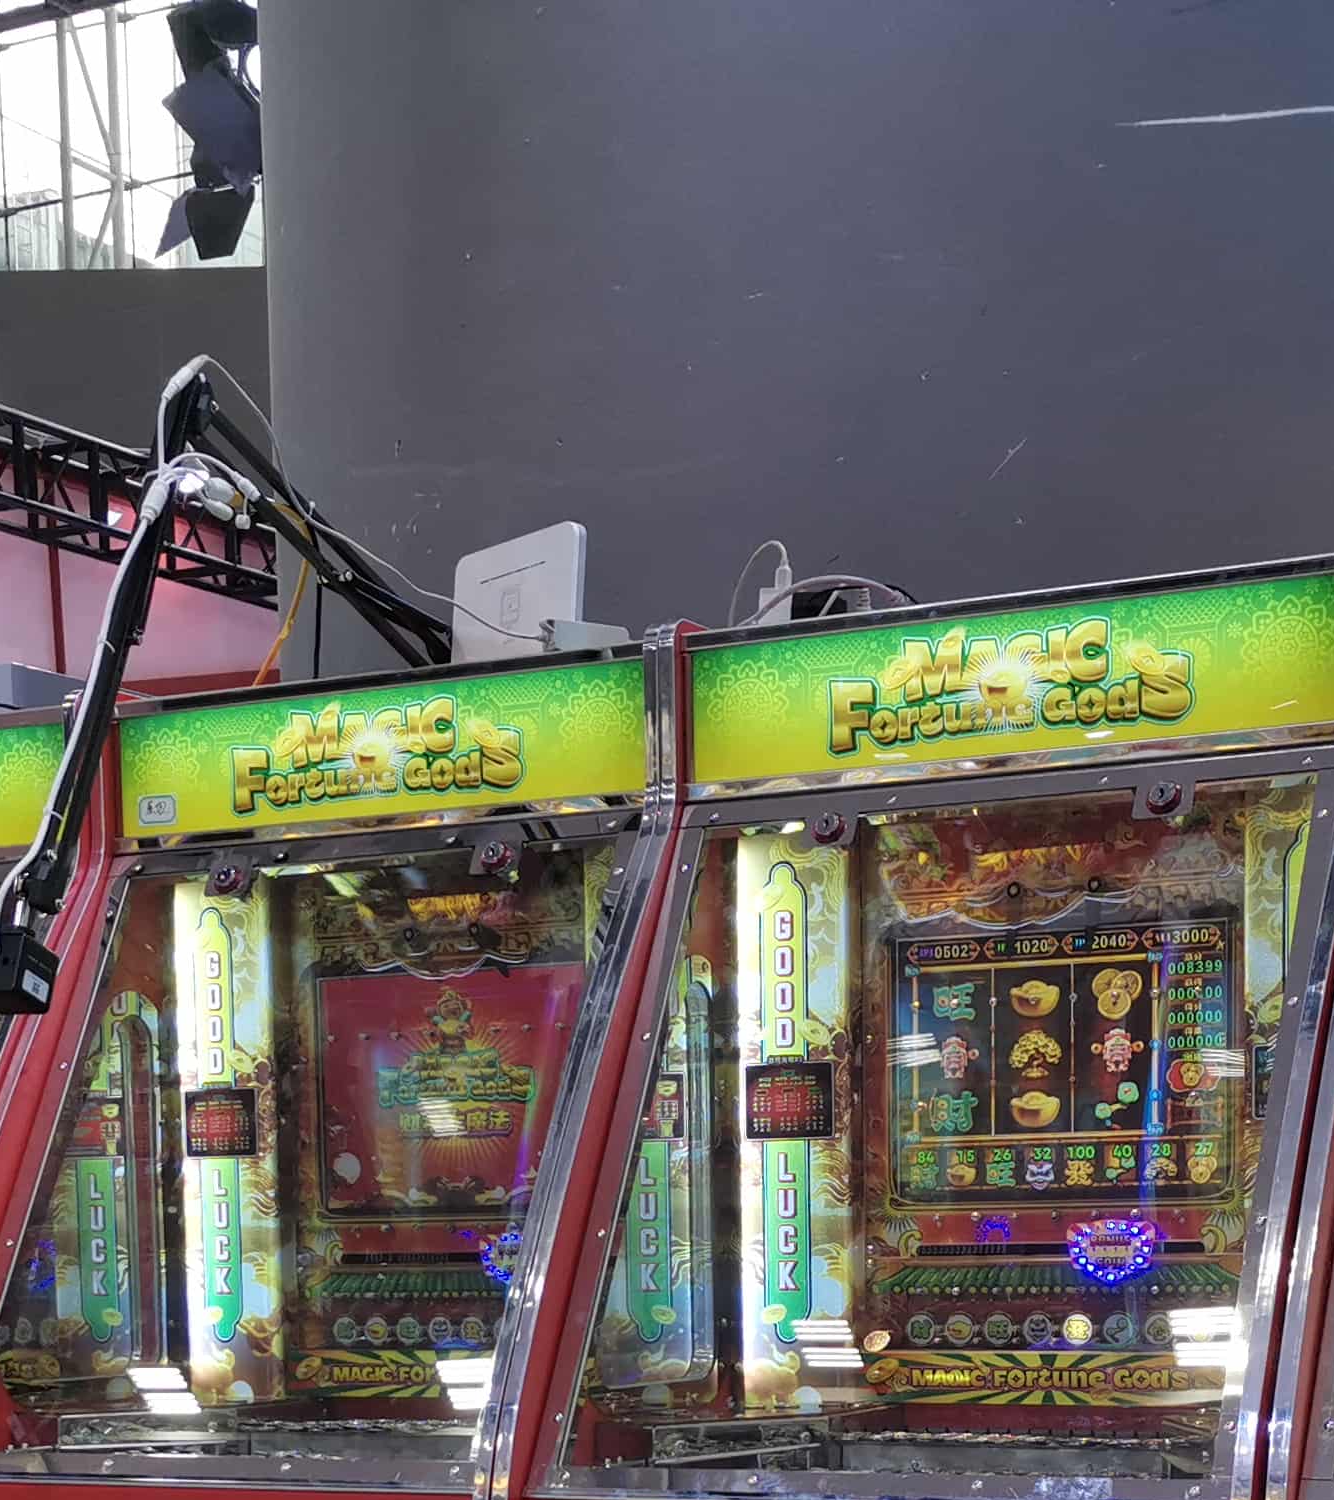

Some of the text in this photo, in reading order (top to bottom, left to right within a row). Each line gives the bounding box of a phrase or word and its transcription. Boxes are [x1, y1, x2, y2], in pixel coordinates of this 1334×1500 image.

[1092, 934, 1127, 949] 2040
[1172, 928, 1209, 944] 3000
[1014, 939, 1049, 954] 1020
[1168, 960, 1223, 975] 008399
[1168, 1010, 1223, 1025] 000000
[1033, 1147, 1053, 1161] 32
[1113, 1144, 1133, 1159] 40
[776, 1152, 799, 1293] LUCK
[211, 1168, 234, 1297] LUCK
[333, 1366, 394, 1382] MAGIC
[992, 1367, 1105, 1391] Fortune
[1110, 1366, 1189, 1390] Gods
